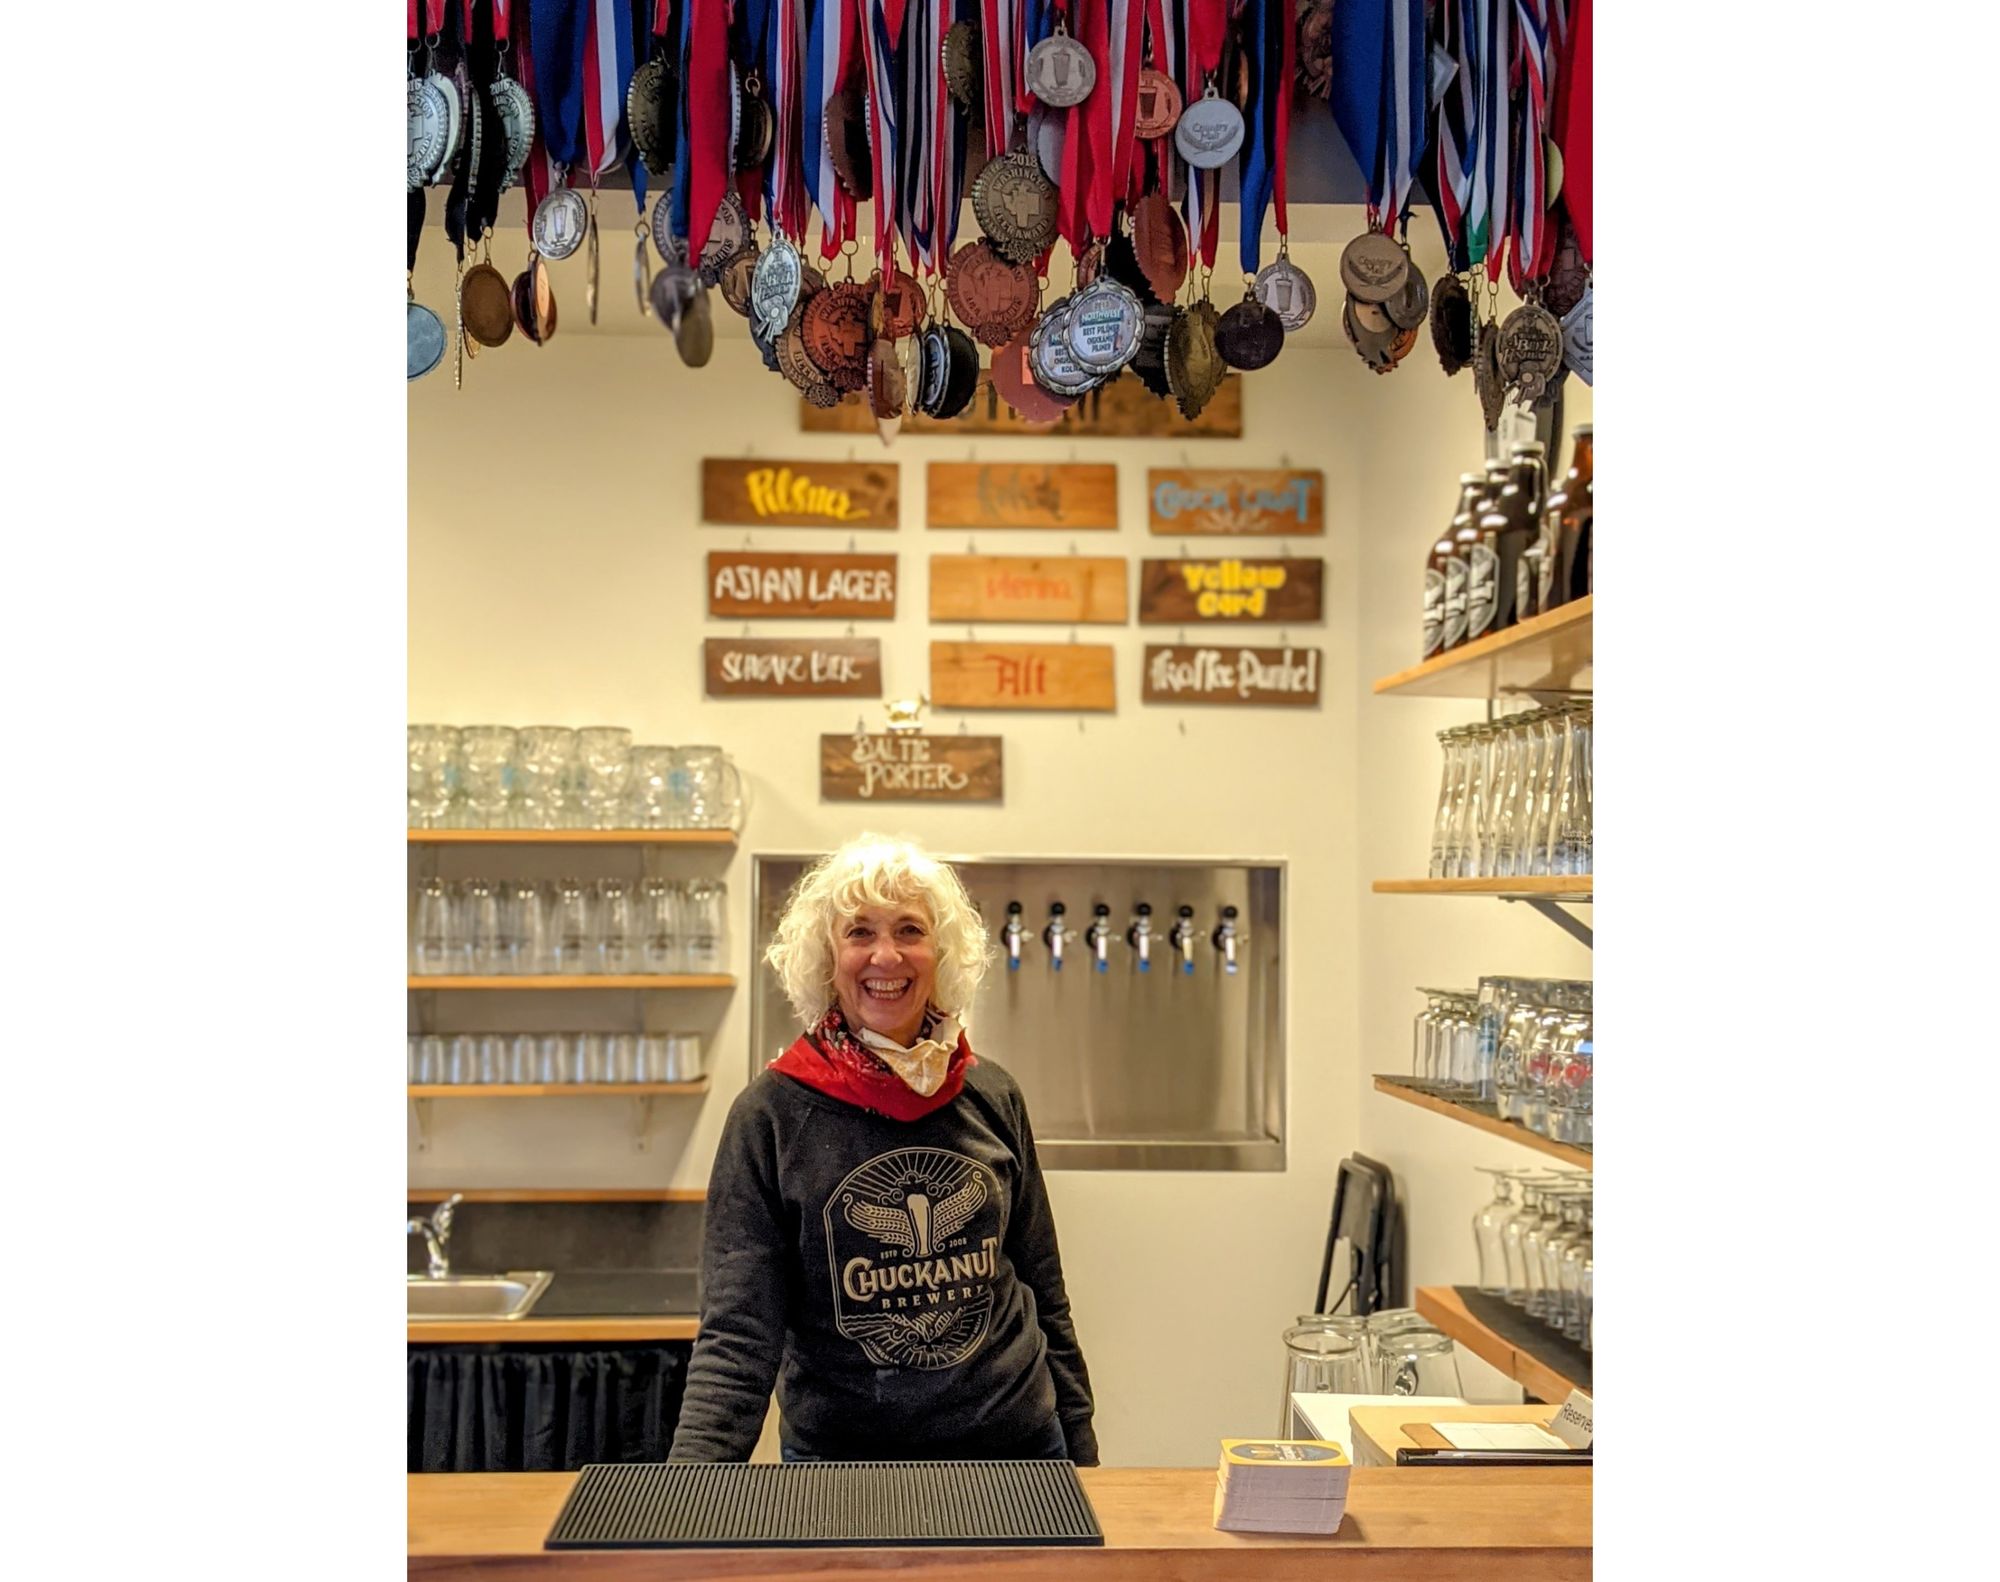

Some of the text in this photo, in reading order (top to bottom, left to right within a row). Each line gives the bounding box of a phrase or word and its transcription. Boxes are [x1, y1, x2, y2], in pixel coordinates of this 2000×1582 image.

[407, 79, 423, 92] 016
[1006, 152, 1039, 168] 2018
[714, 564, 895, 604] ASIAN LAGER
[983, 652, 1048, 697] Alt
[858, 762, 970, 798] PORTER
[842, 1236, 999, 1303] CHUCKANUT
[881, 1284, 985, 1310] BREWERY
[1561, 1402, 1593, 1434] Reserve
